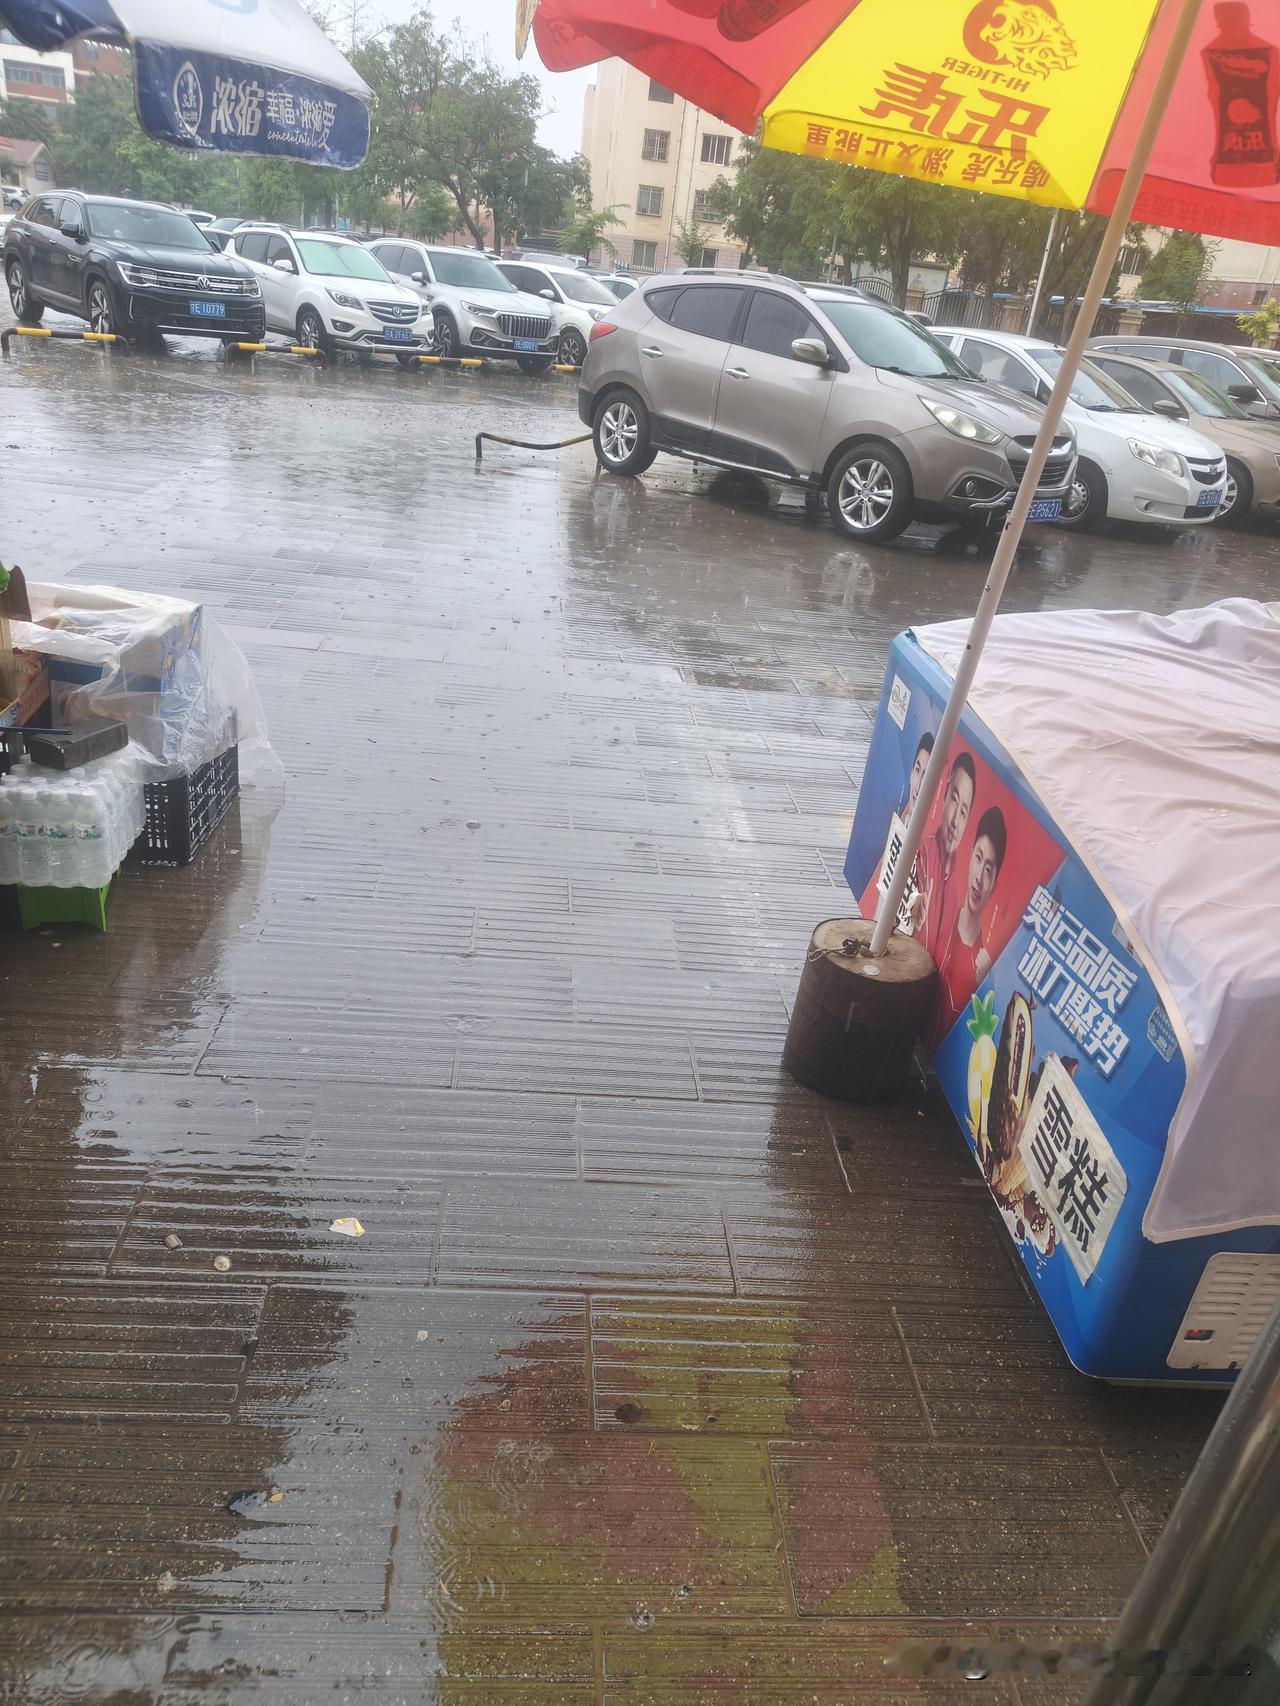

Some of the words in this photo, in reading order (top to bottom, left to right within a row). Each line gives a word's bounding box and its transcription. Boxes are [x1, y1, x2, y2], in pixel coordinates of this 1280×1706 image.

[210, 75, 265, 136] 浓缩
[961, 152, 1051, 188] 喝乐虎
[1028, 503, 1060, 518] EP5621
[1023, 884, 1138, 1014] 奥运品质
[1030, 1084, 1109, 1252] 雪糕
